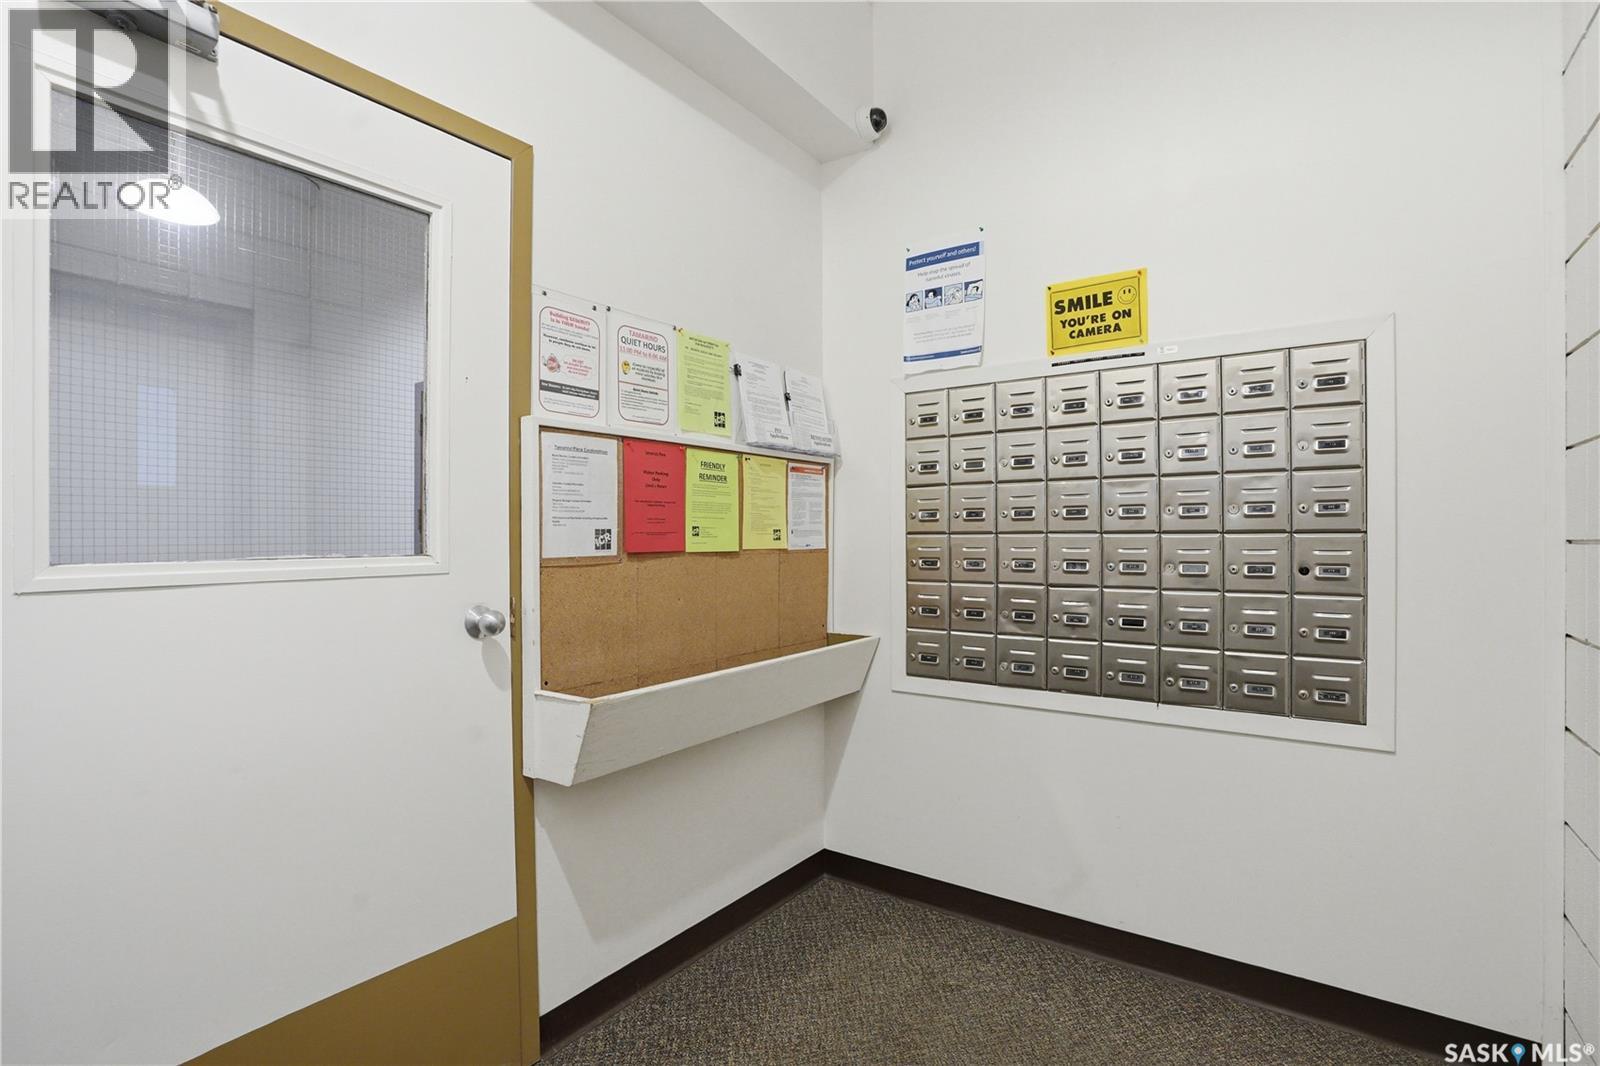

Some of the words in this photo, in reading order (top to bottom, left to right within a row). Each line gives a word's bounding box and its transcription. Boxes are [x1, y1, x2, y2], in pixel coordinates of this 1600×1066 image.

[908, 258, 926, 266] Protect
[926, 252, 946, 263] yourself
[946, 249, 958, 257] and
[1054, 290, 1113, 315] SMILE
[1060, 312, 1106, 329] YOU'RE
[1112, 308, 1132, 320] ON
[1069, 322, 1122, 339] CAMERA
[620, 335, 641, 347] QUIET
[643, 341, 666, 353] HOURS
[700, 460, 726, 470] FRIENDLY
[698, 473, 727, 483] REMINDER
